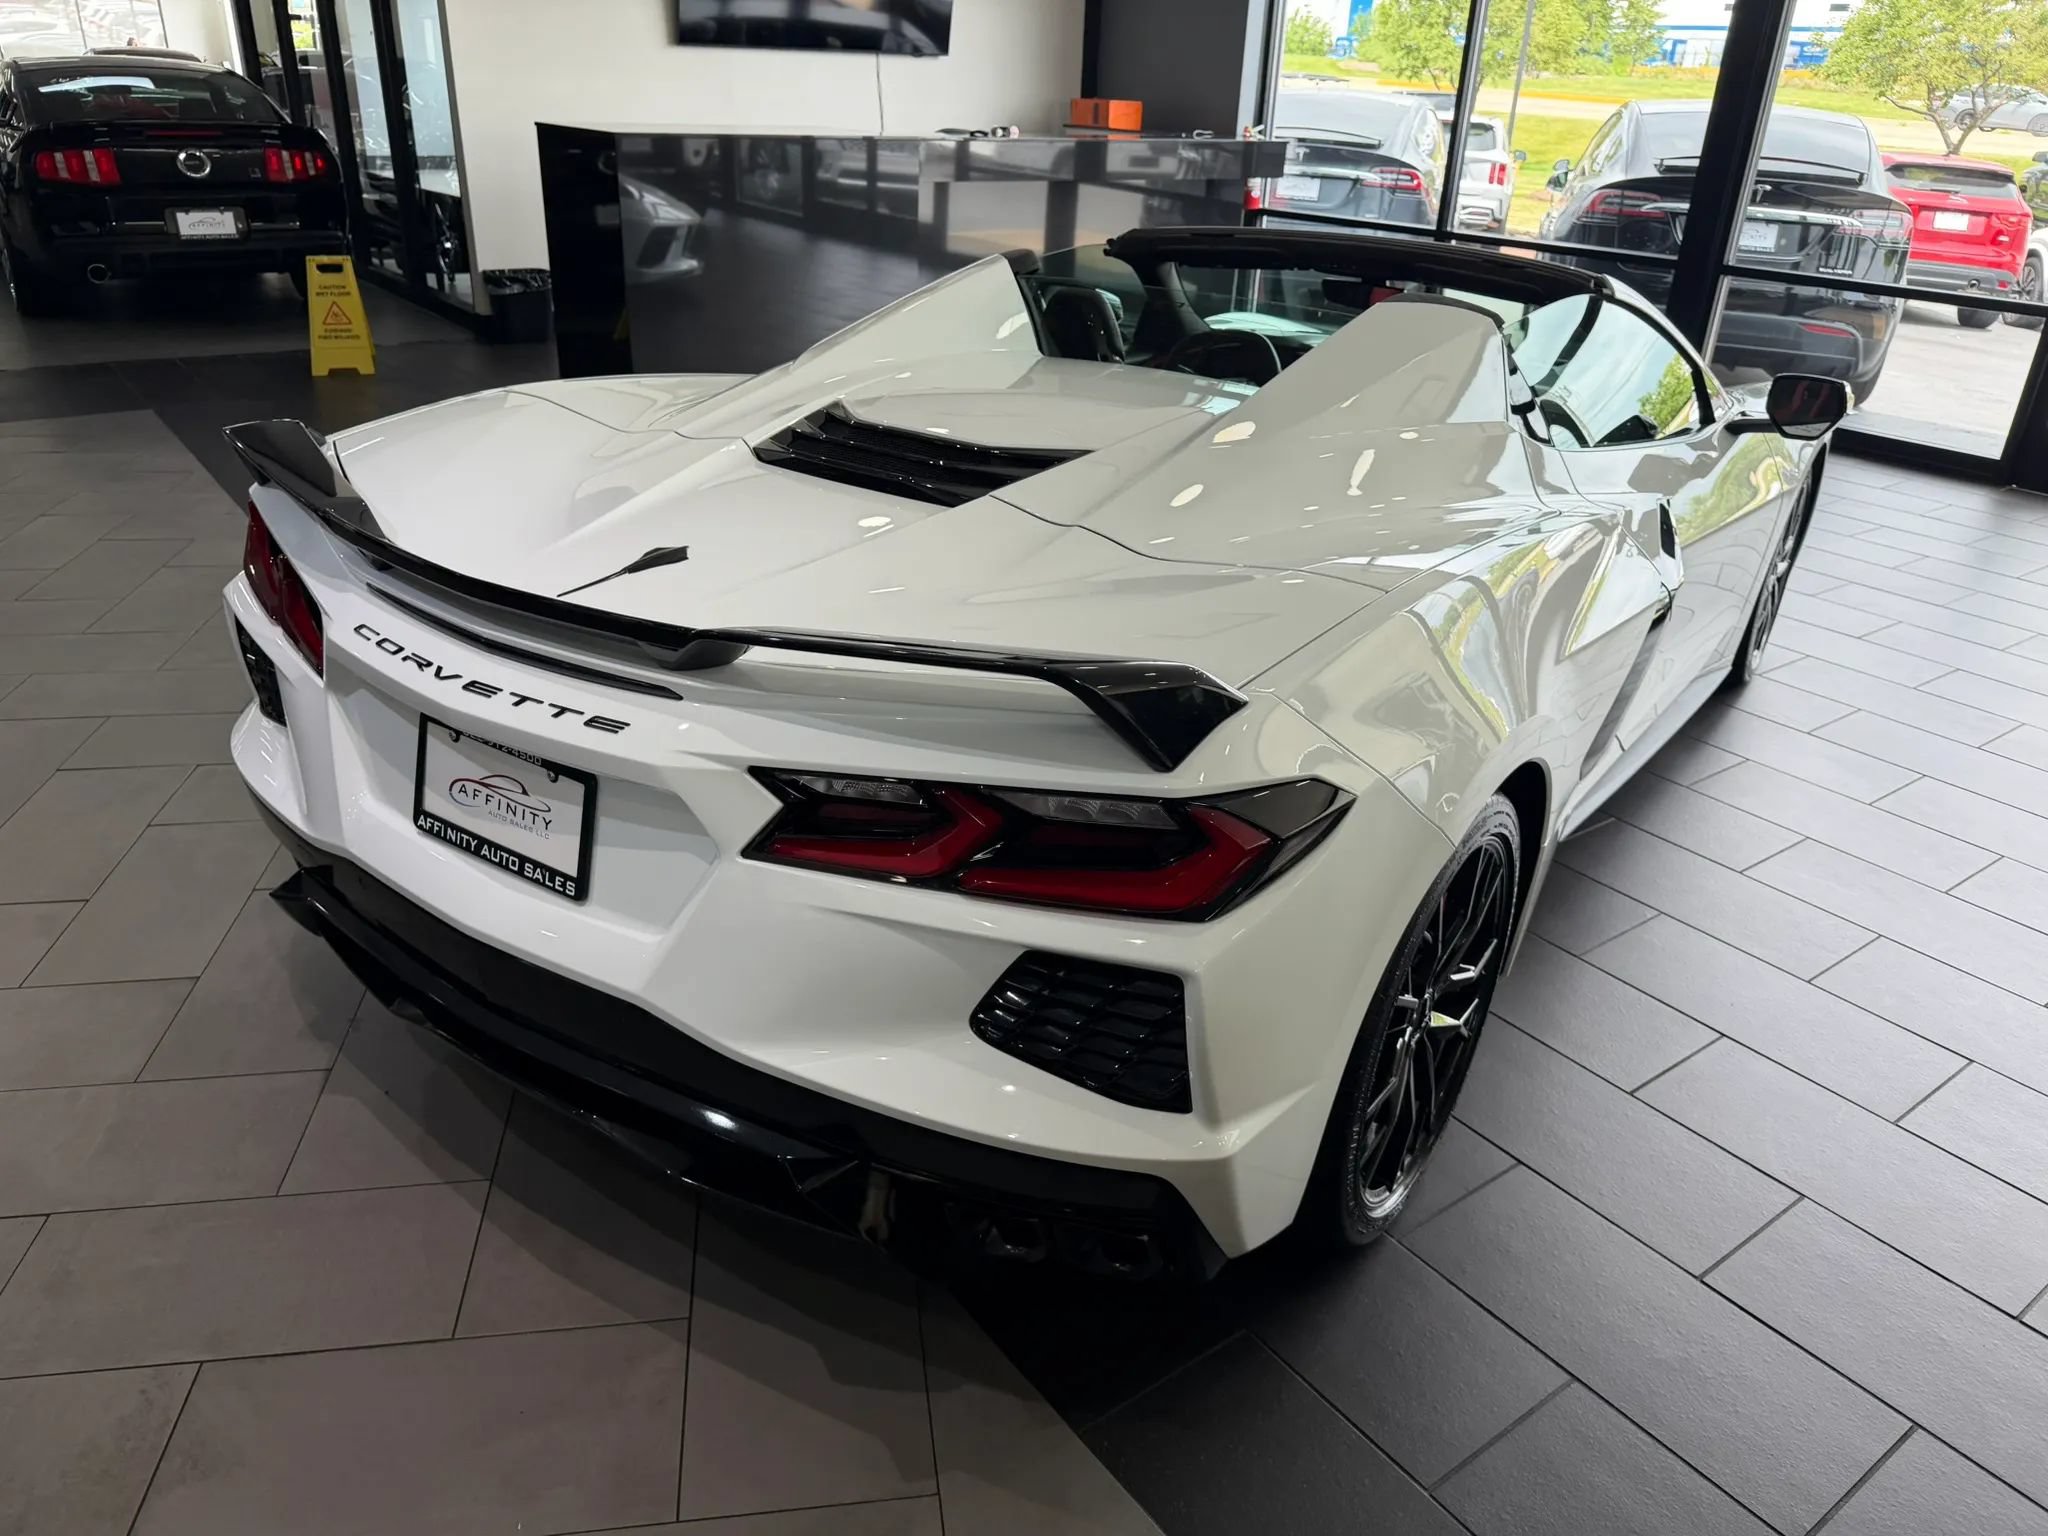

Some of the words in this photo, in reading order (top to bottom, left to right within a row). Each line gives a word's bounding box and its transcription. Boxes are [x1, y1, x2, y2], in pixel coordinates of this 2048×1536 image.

[353, 623, 631, 735] CORVETTE
[458, 783, 553, 831] AFFINITY
[488, 809, 508, 822] AUTO
[416, 814, 478, 852] AFFINITY
[480, 843, 519, 871] AUTO
[523, 862, 576, 897] SALES
